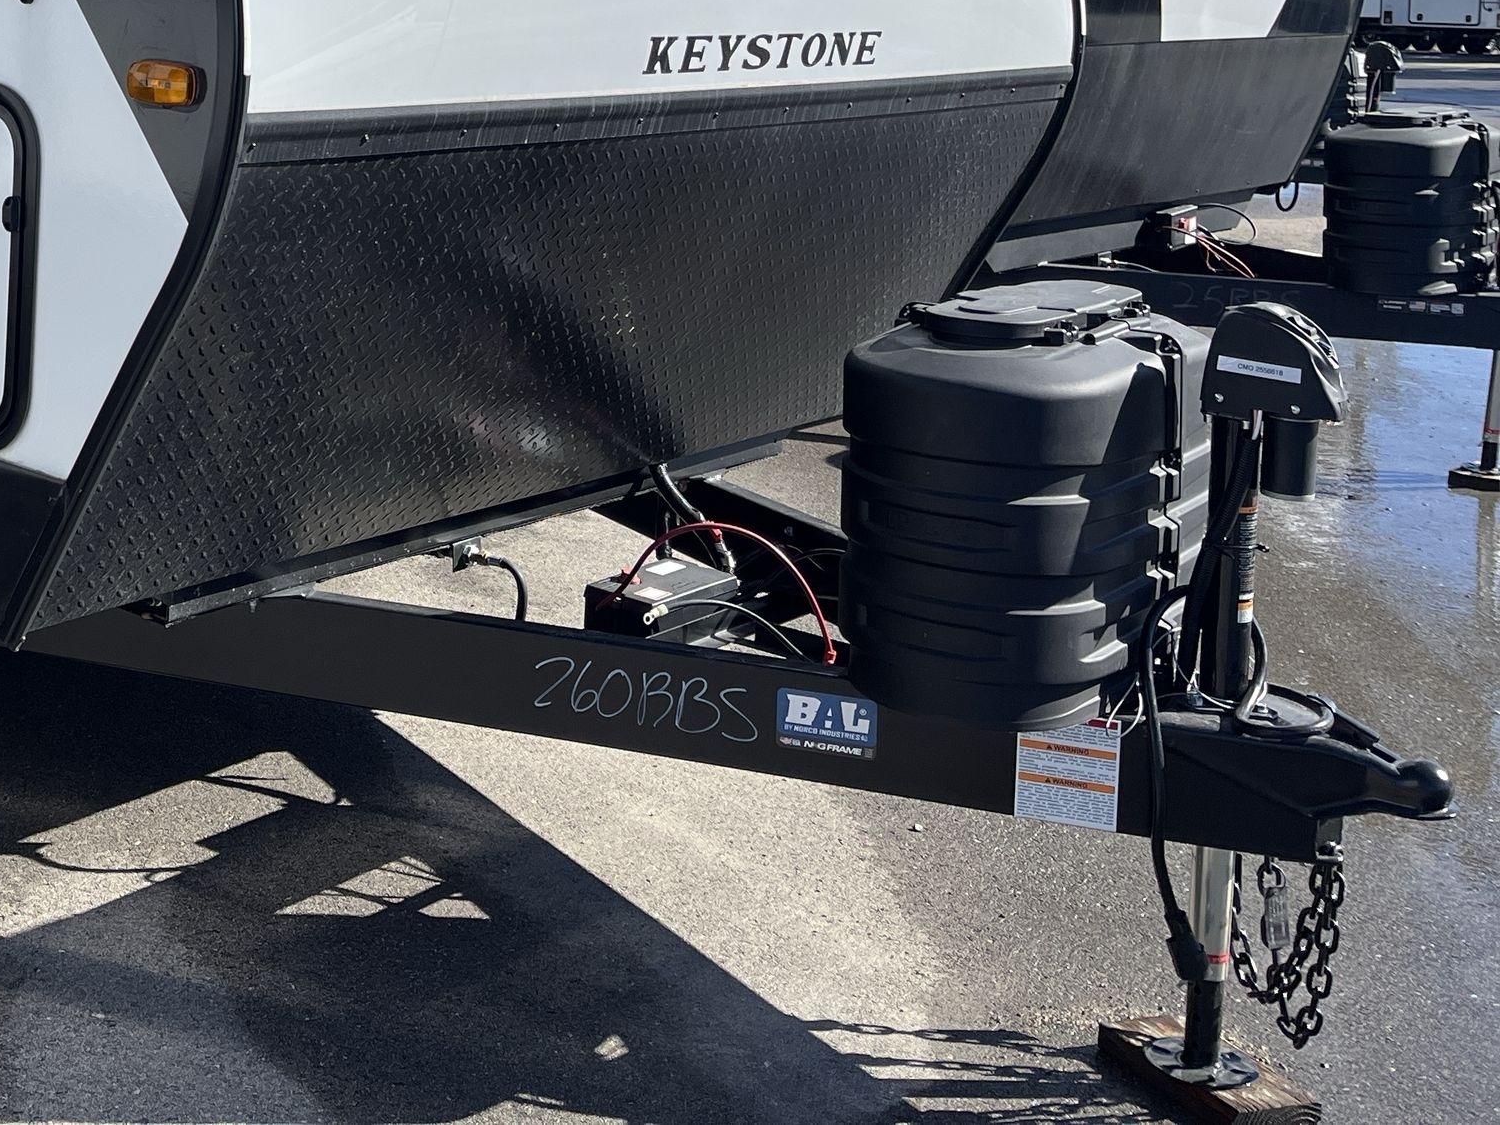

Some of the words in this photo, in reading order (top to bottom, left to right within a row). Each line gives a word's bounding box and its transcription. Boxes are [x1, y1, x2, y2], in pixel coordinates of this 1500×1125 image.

[642, 31, 882, 75] KEYSTONE
[534, 656, 758, 742] 260RBS
[785, 694, 870, 734] BAL
[793, 725, 818, 734] NORCO
[819, 729, 861, 741] INDUSTRIES
[1054, 744, 1090, 756] WARNING
[1052, 777, 1088, 789] WARNING
